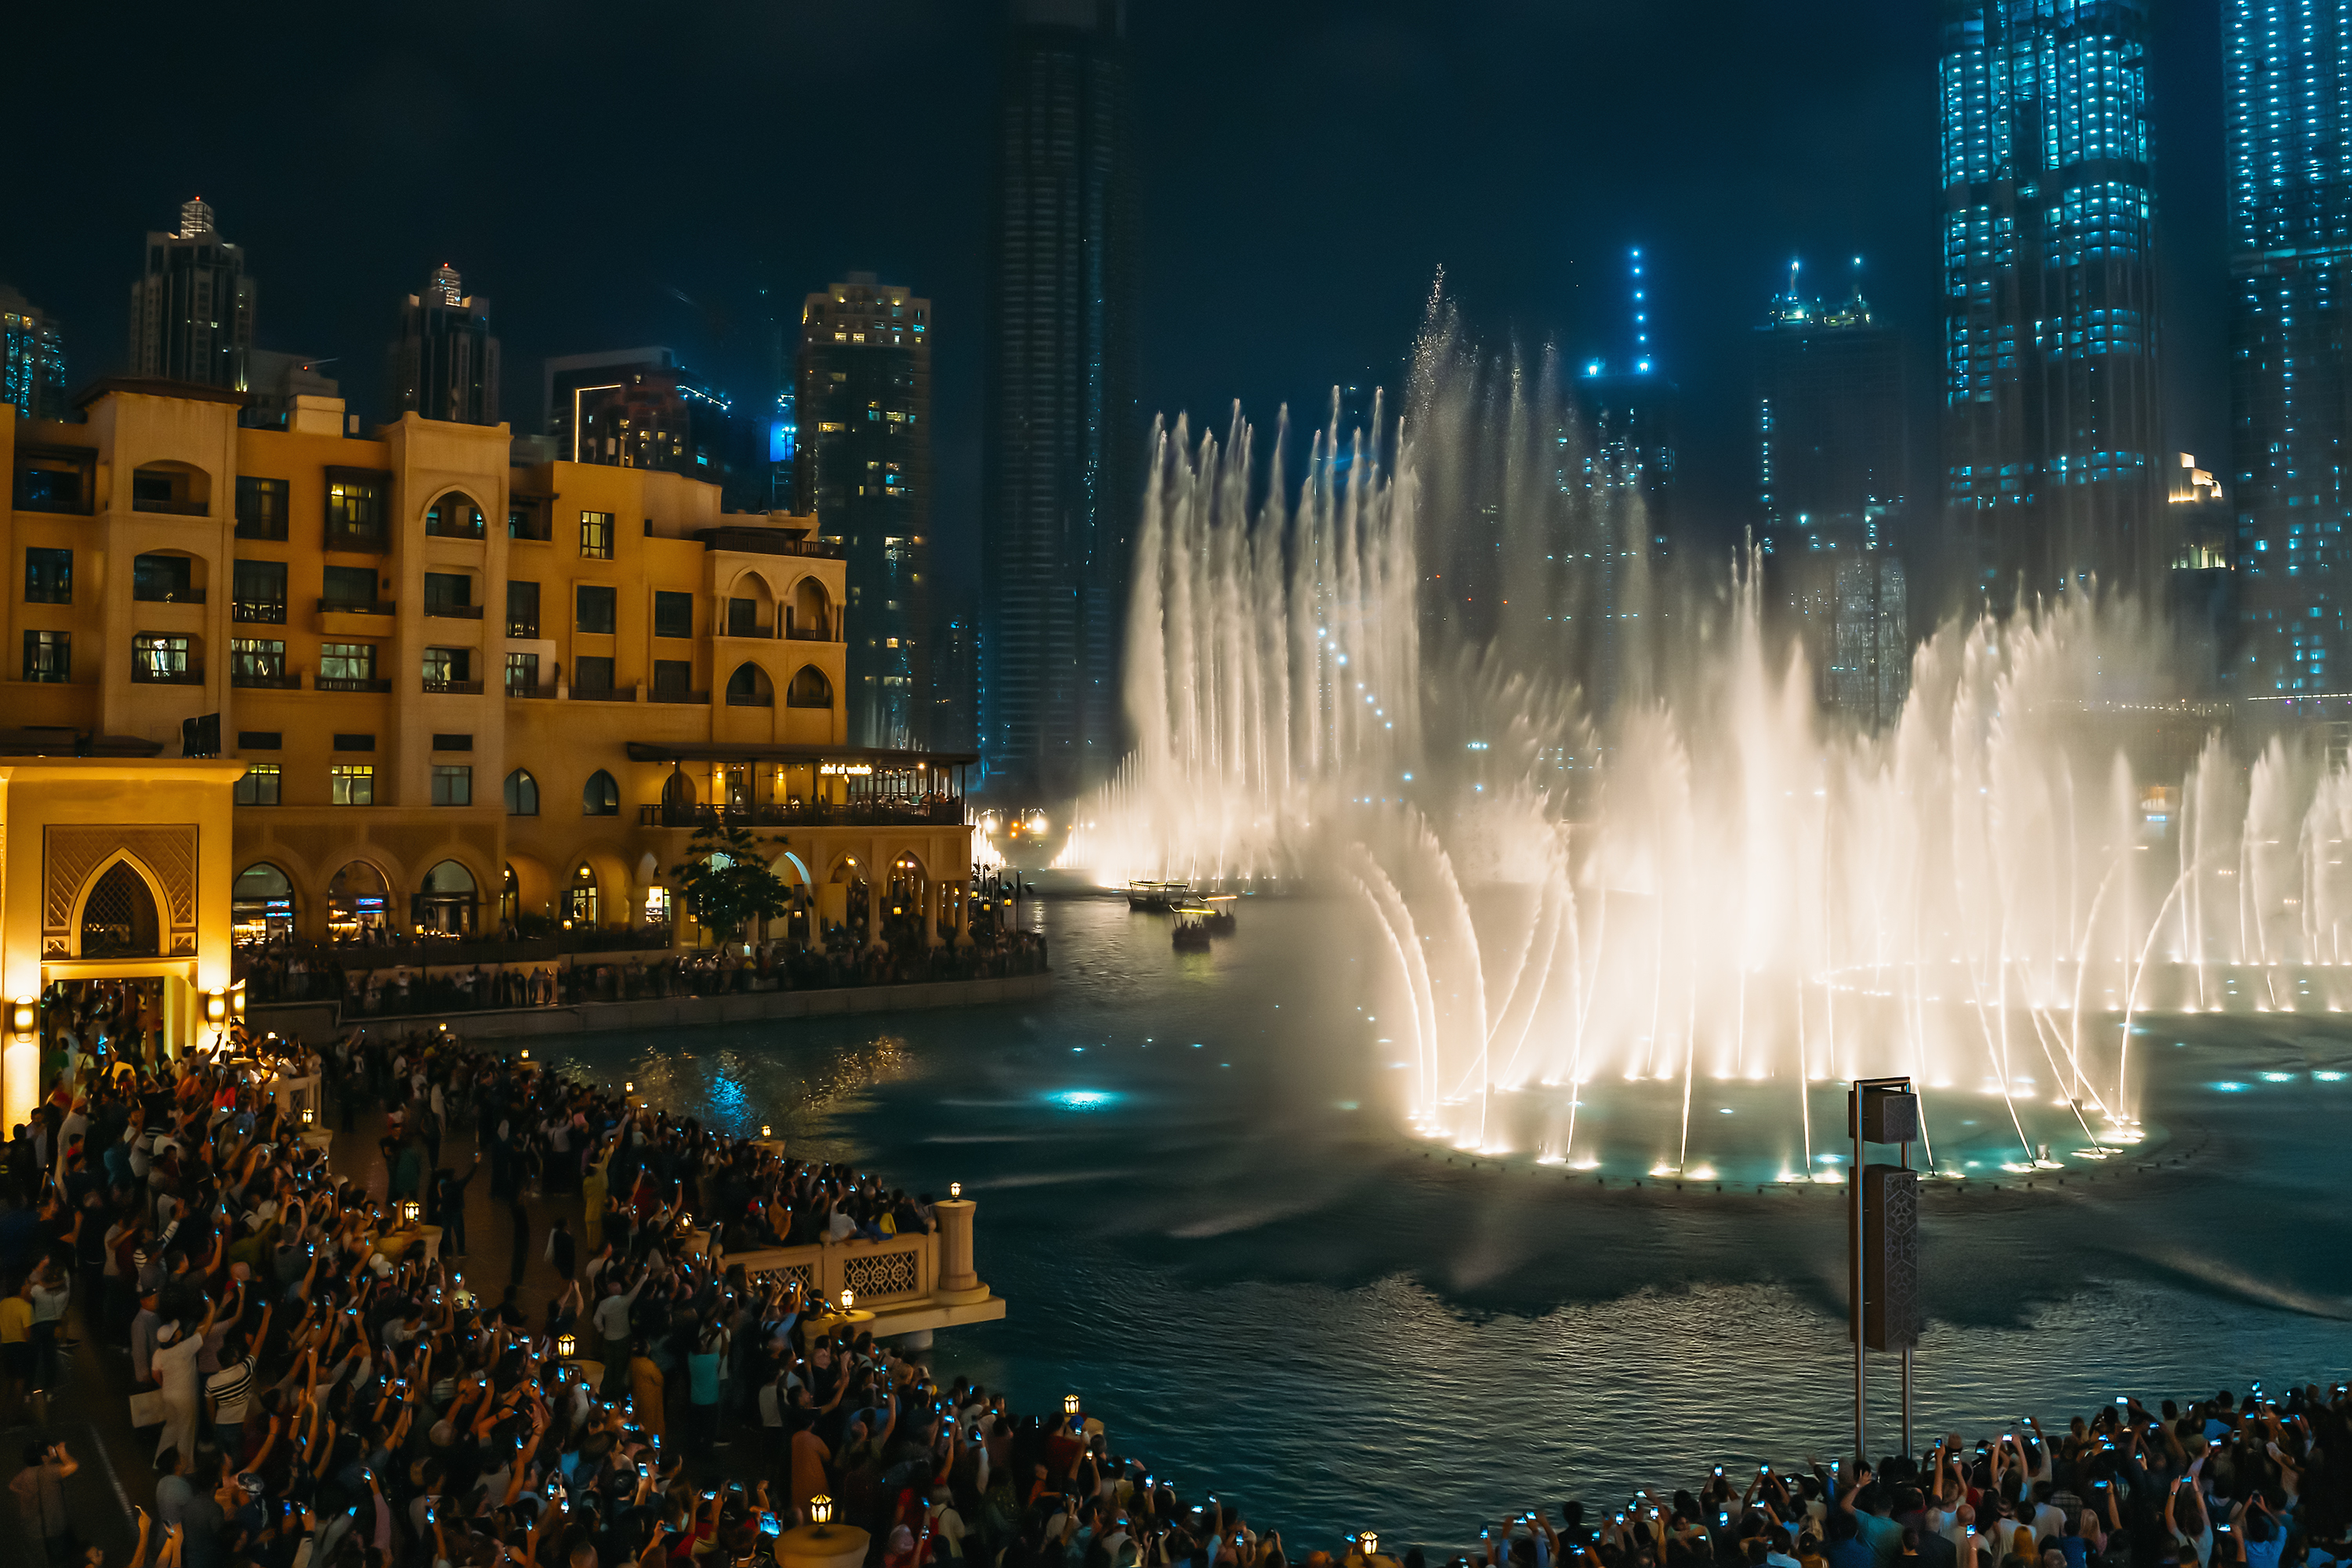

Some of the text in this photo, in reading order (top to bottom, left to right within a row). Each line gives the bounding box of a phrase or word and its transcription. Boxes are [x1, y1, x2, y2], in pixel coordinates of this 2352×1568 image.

[821, 763, 872, 774] abd el wahab
